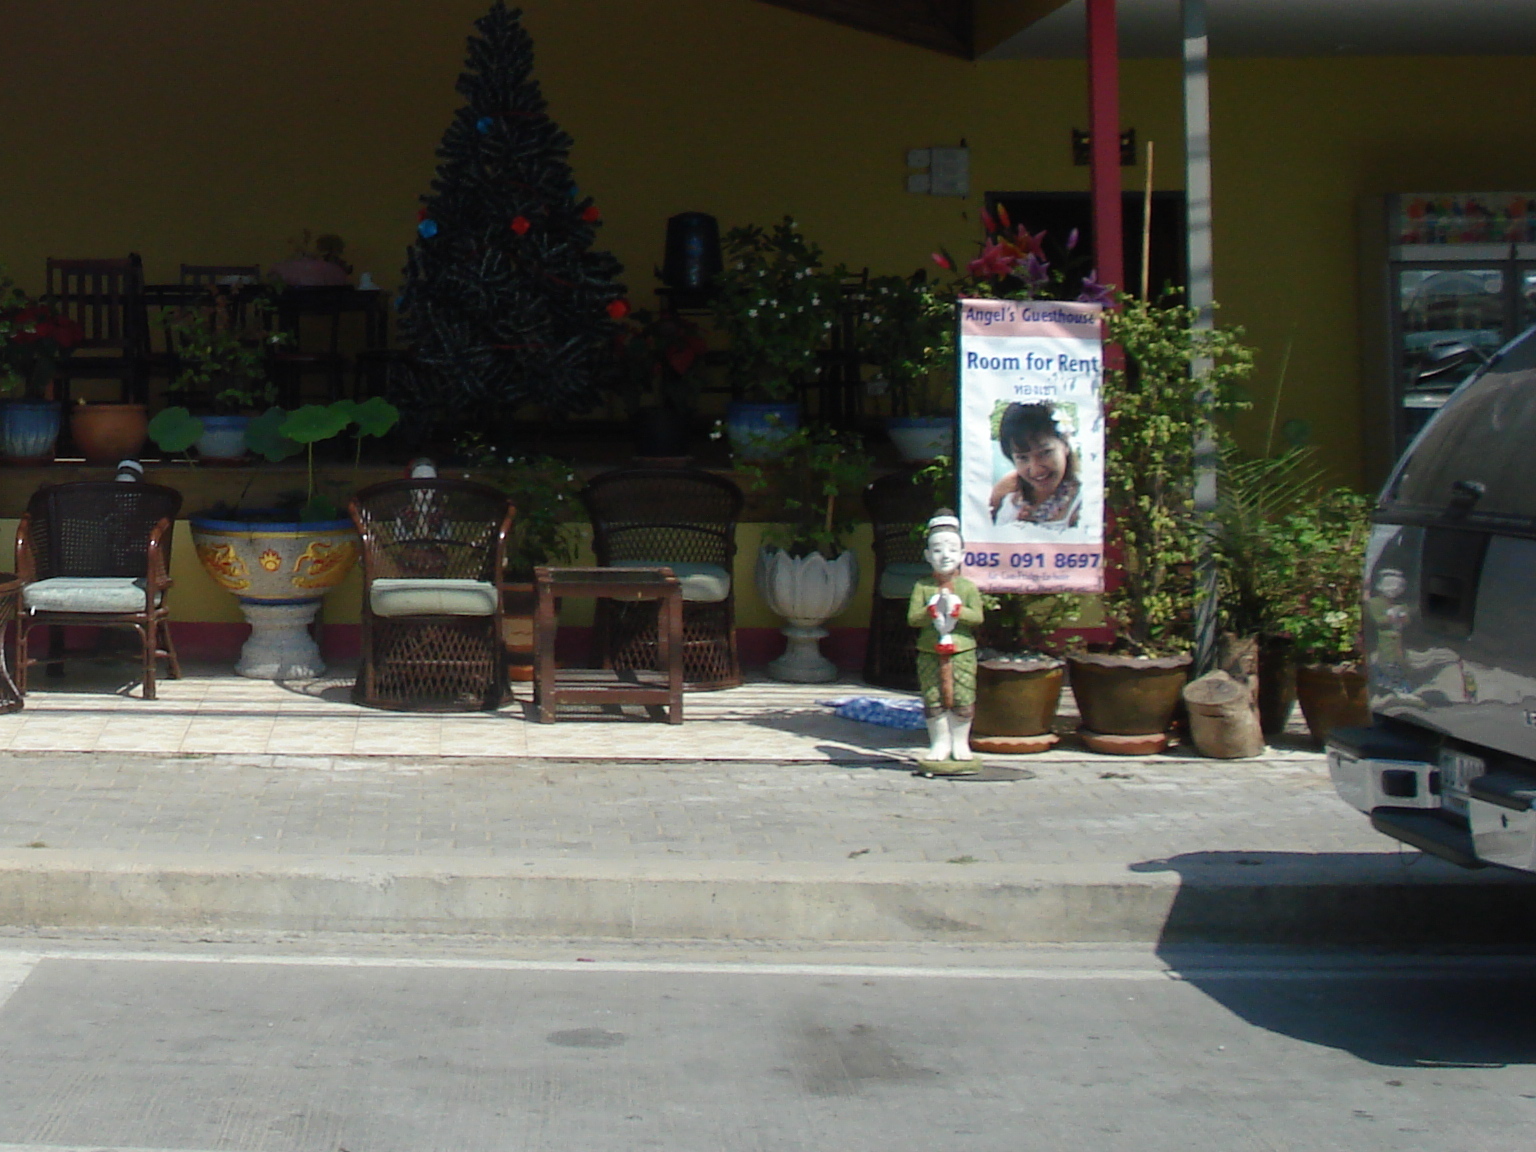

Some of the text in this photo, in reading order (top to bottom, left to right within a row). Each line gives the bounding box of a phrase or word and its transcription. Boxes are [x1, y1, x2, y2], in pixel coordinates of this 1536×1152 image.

[966, 307, 1095, 326] Angel's Guesthouse
[967, 351, 1100, 373] Room for Rent
[965, 552, 1101, 568] 085 091 8697
